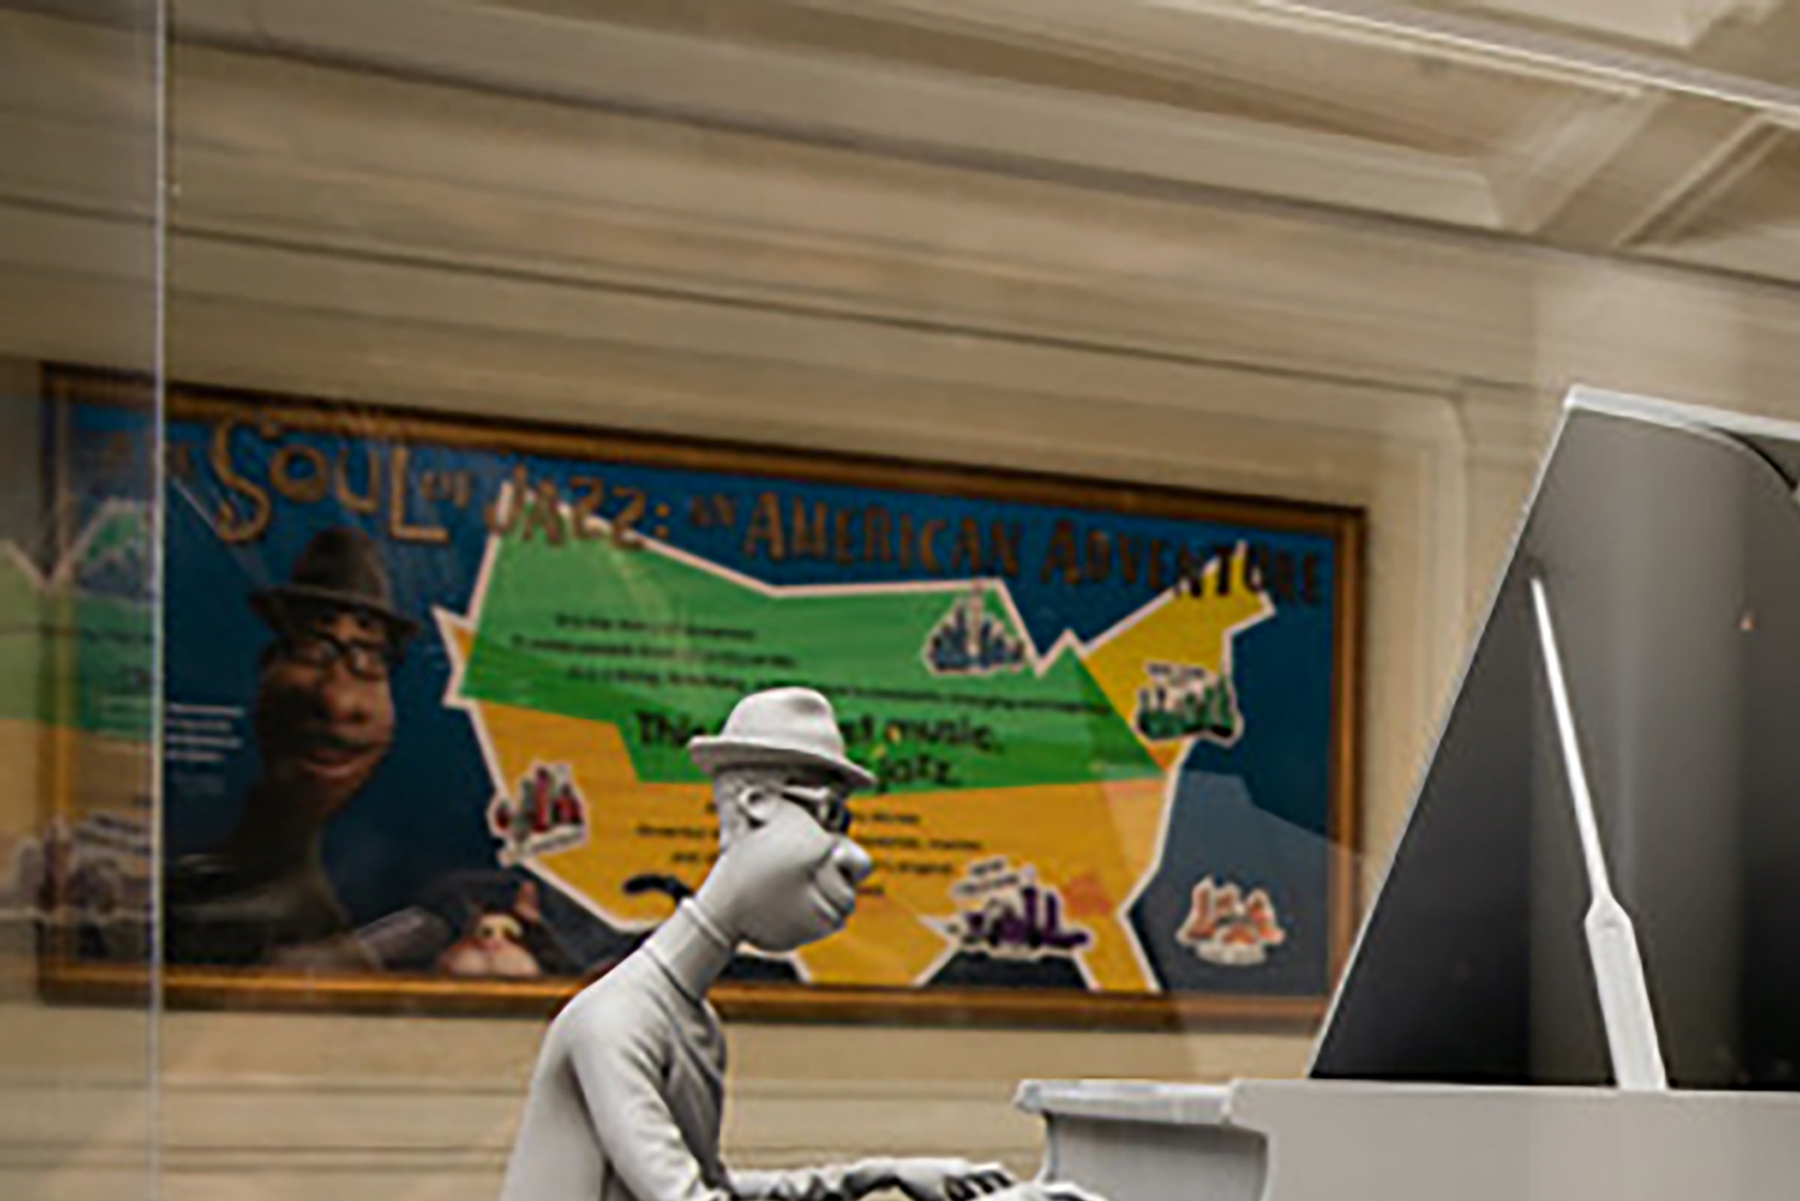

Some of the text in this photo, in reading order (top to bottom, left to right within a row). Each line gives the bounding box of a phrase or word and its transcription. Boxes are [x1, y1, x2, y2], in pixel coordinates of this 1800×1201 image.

[208, 414, 449, 543] SOUL
[743, 490, 1020, 580] AMERICAN
[1040, 519, 1322, 607] ADVENTURE
